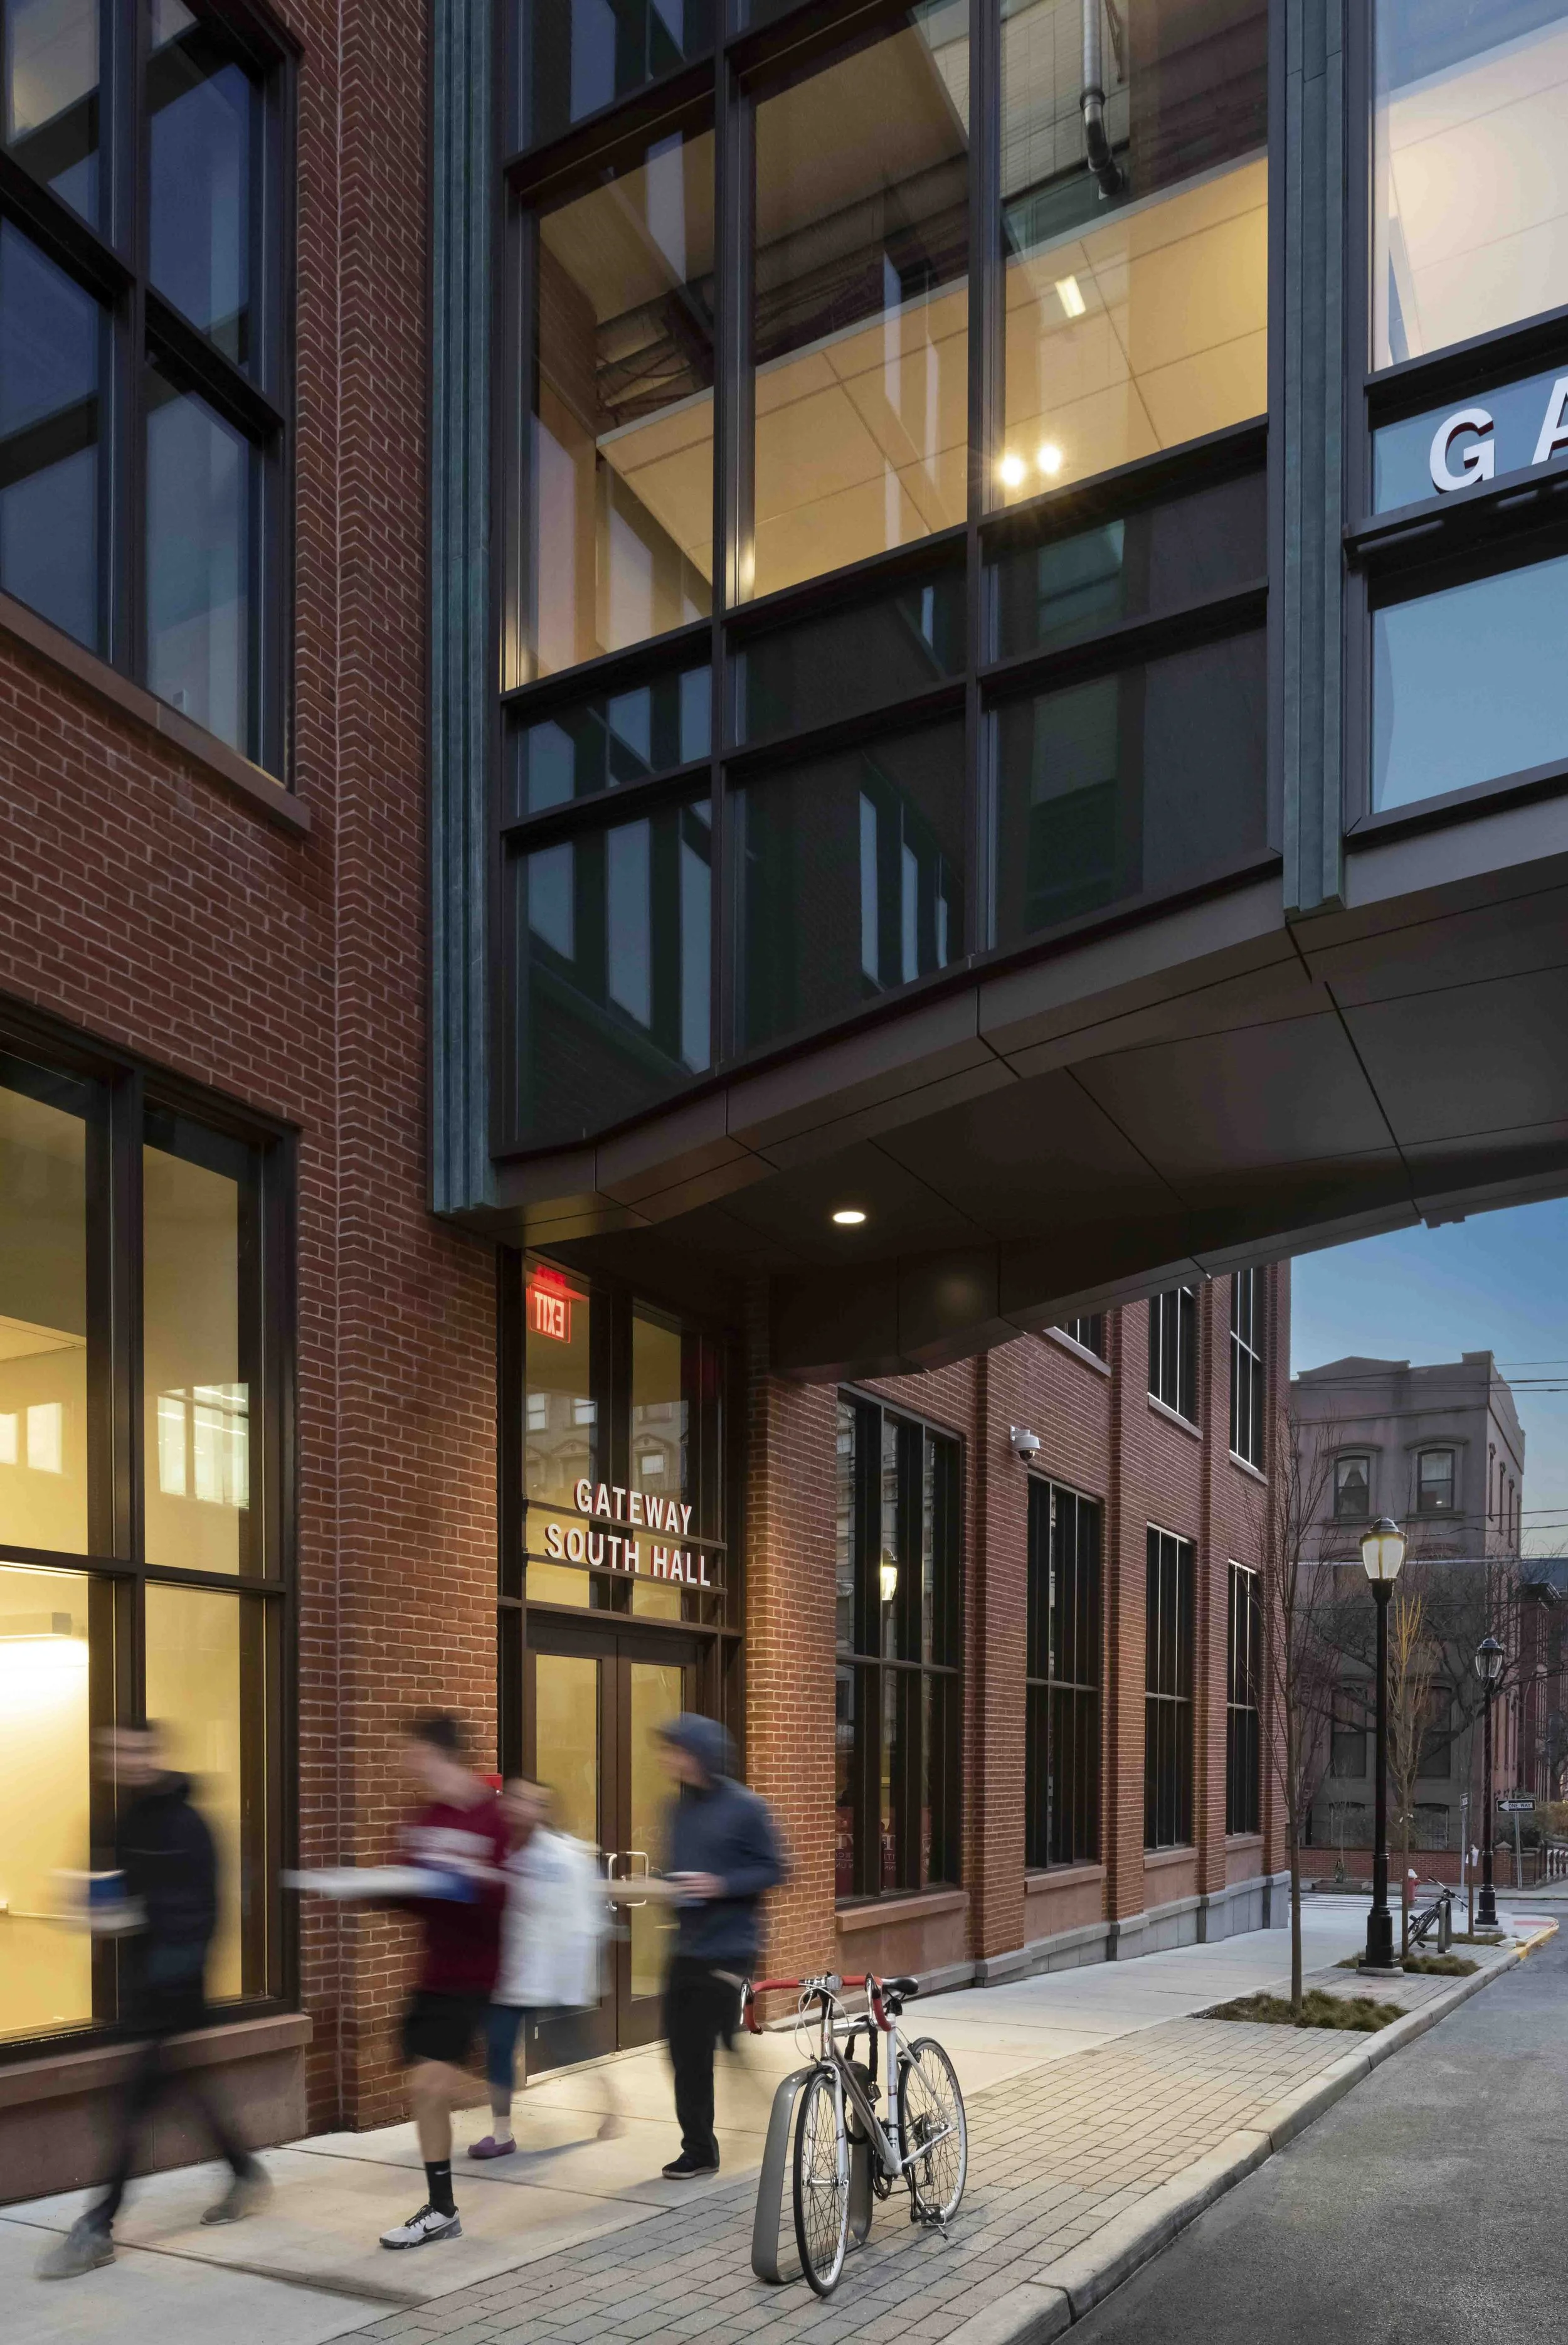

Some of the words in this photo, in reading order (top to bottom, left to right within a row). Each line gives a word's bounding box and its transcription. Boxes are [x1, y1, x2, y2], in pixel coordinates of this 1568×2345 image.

[575, 1478, 692, 1535] GATEWAY
[545, 1523, 639, 1573] SOUTH
[651, 1545, 711, 1587] HALL
